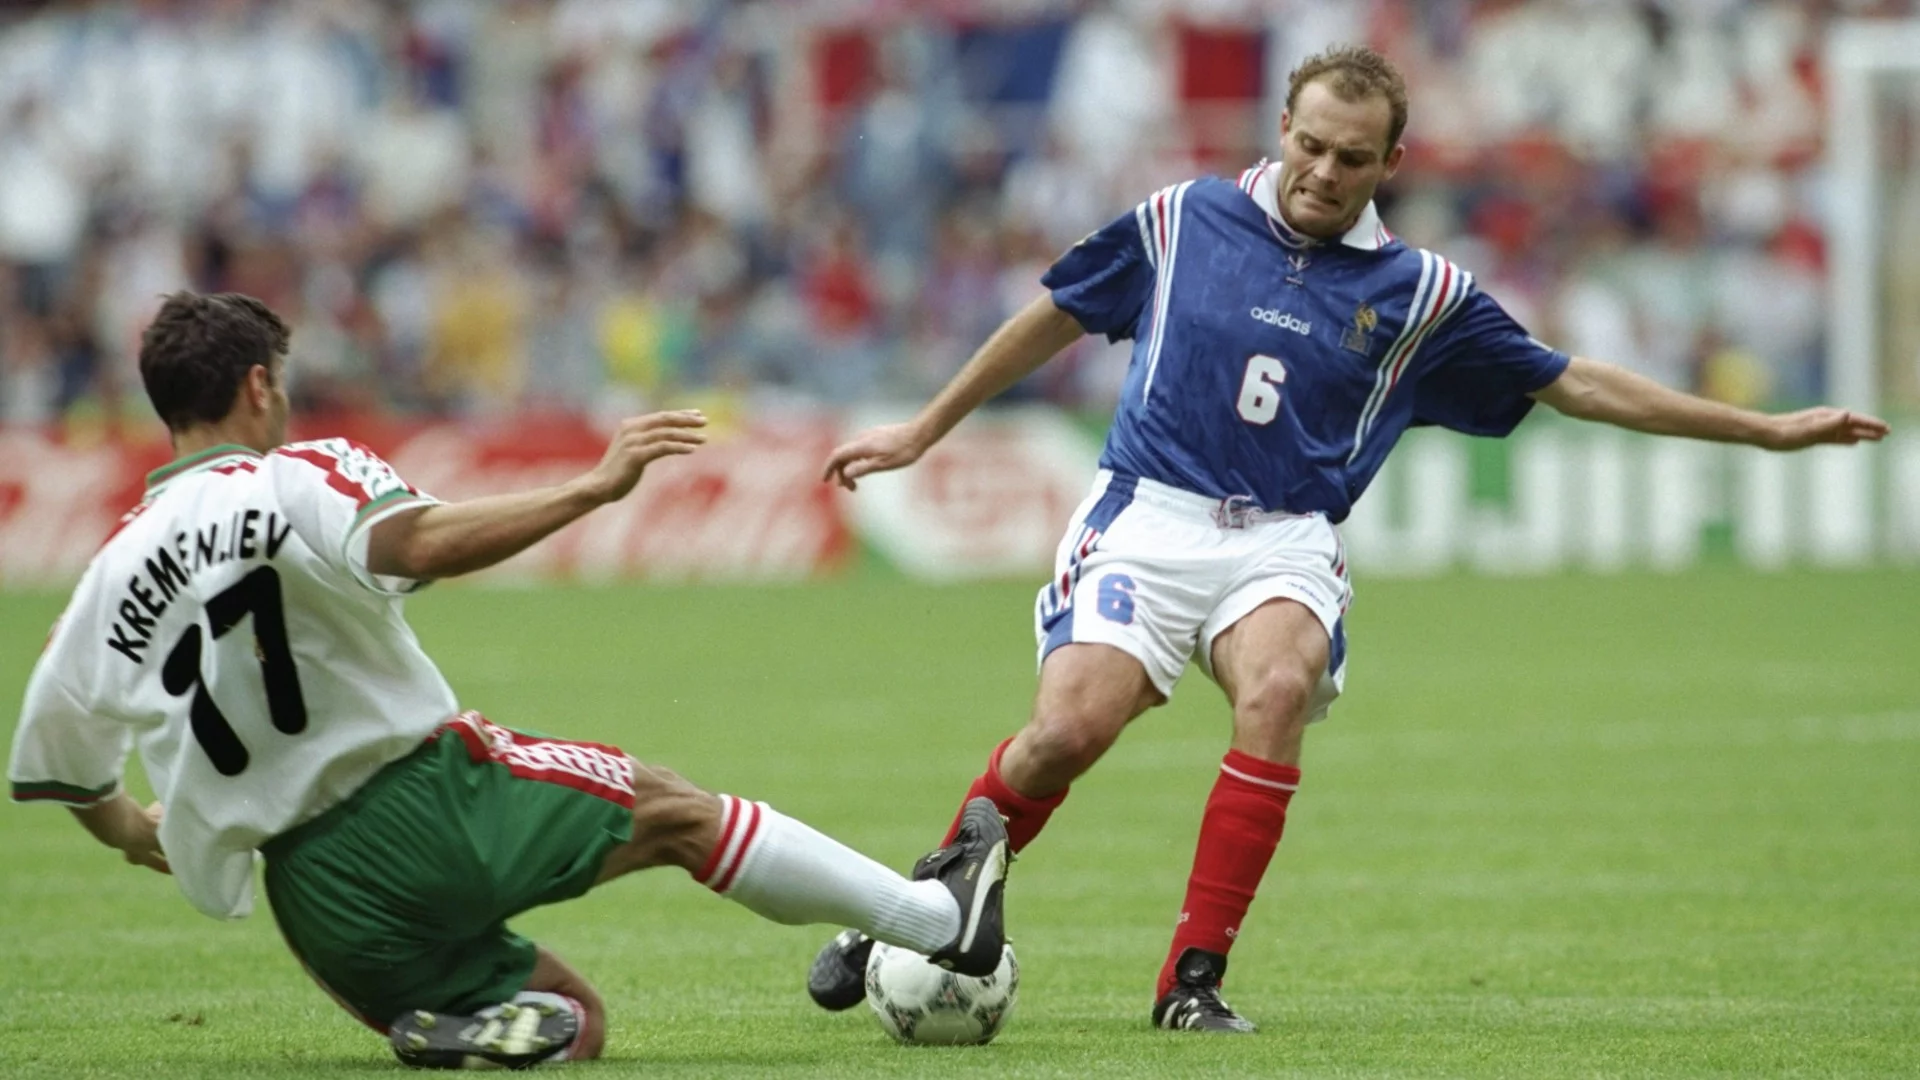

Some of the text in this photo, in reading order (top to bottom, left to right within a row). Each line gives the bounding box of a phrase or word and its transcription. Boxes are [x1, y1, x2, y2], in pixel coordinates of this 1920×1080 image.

[1250, 306, 1312, 336] adidas
[1236, 354, 1287, 426] 6
[1096, 573, 1136, 626] 6
